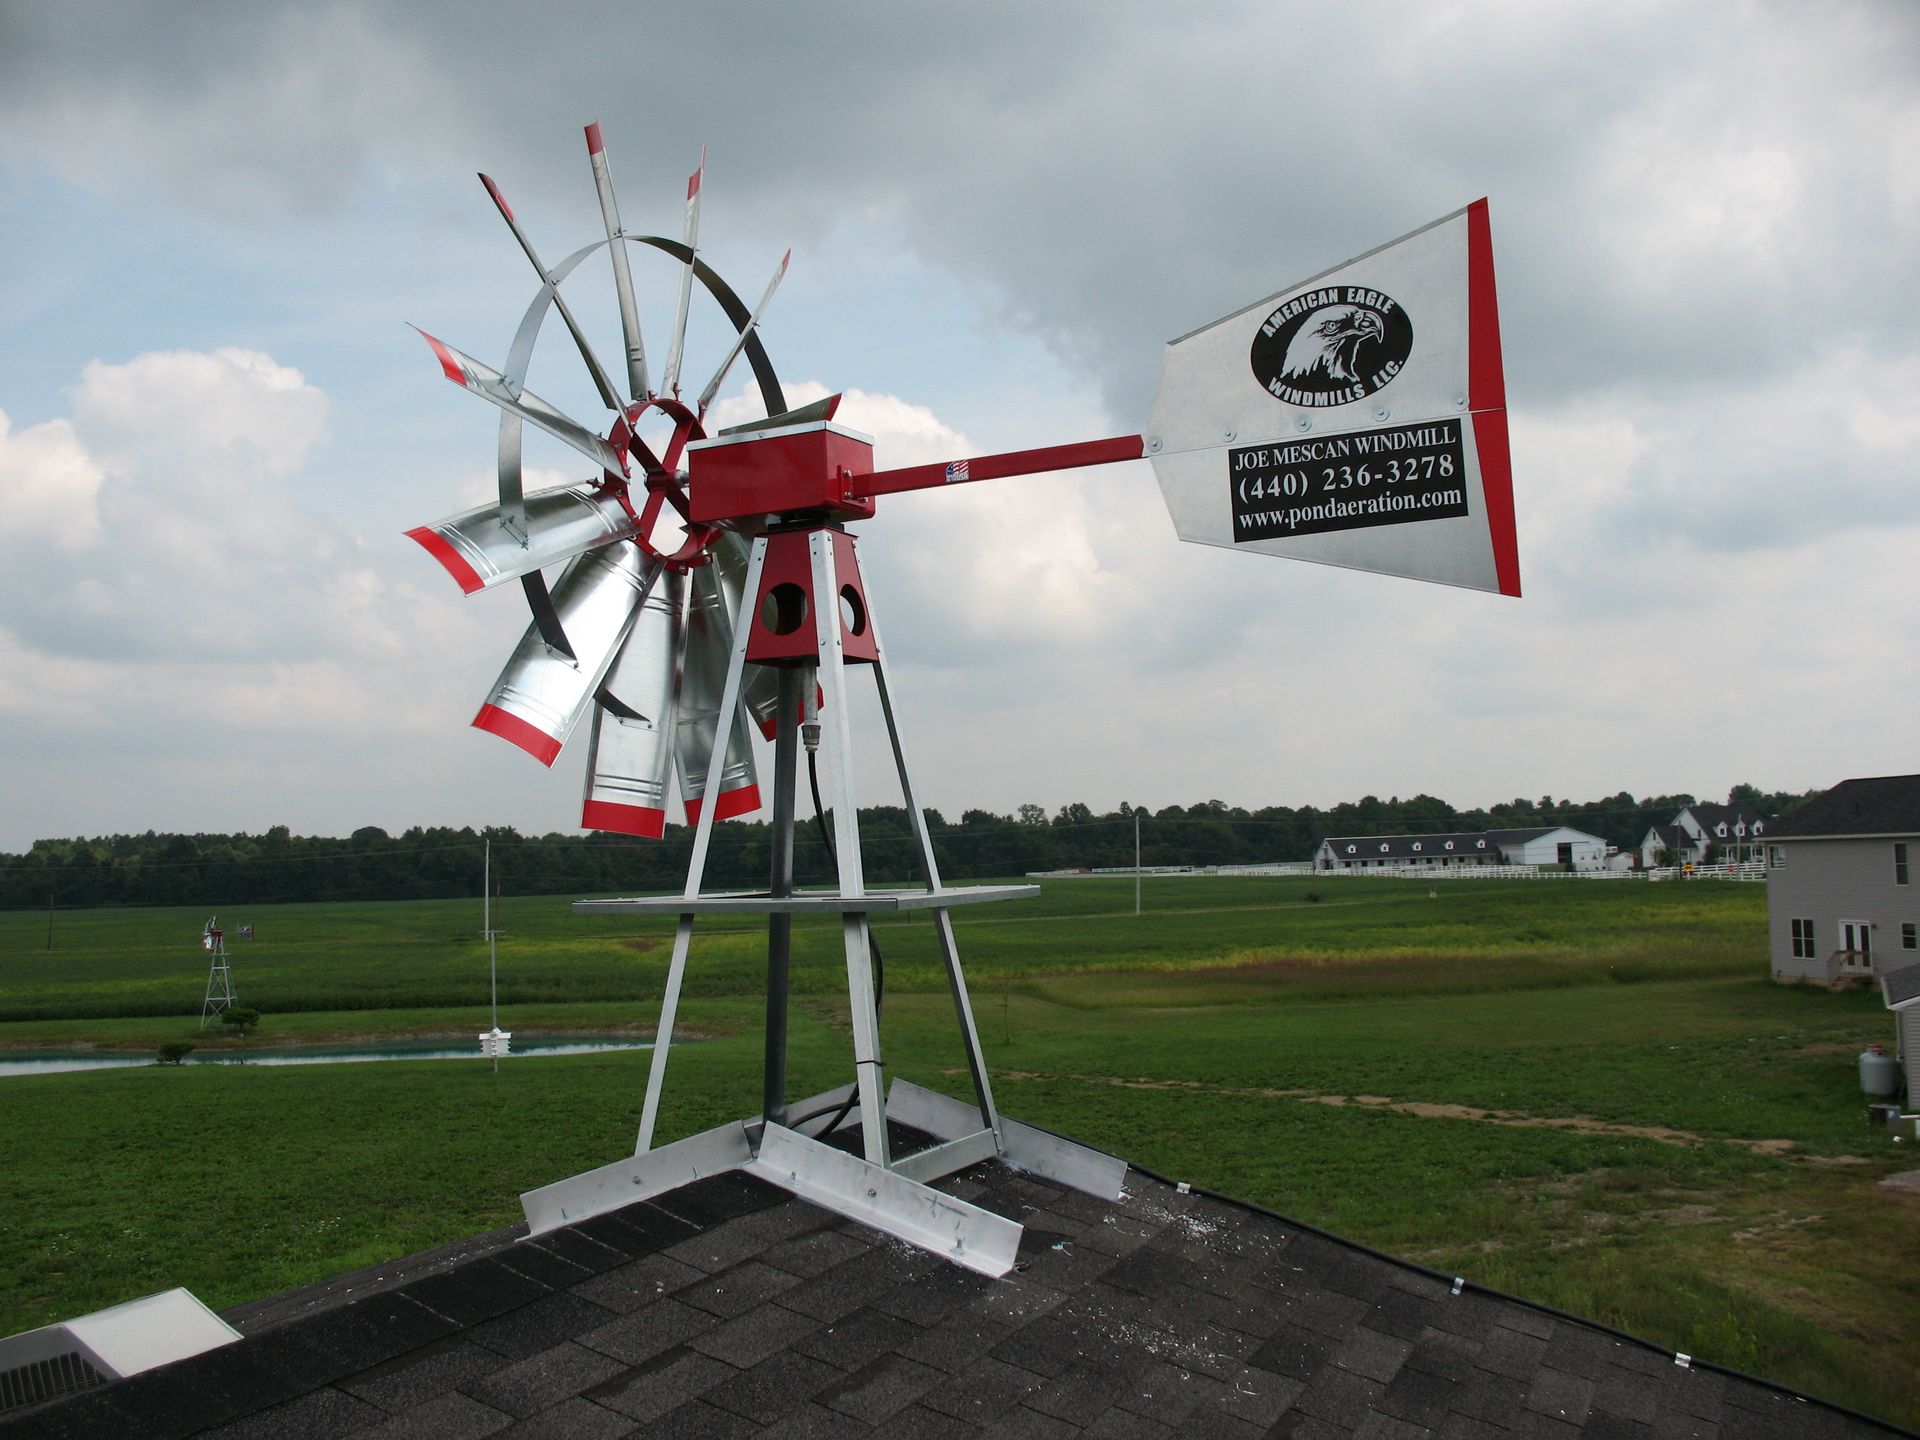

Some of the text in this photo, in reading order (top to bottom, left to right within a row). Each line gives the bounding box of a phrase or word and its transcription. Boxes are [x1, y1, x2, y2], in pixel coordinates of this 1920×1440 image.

[1261, 287, 1395, 338] AMERICAN EAGLE
[1268, 359, 1404, 407] WINDMILLS LLC.
[1235, 426, 1457, 471] JOE MESCAN WINDMILL
[1238, 453, 1454, 504] (440) 236-3278
[1238, 488, 1463, 529] www.pondaeration.com
